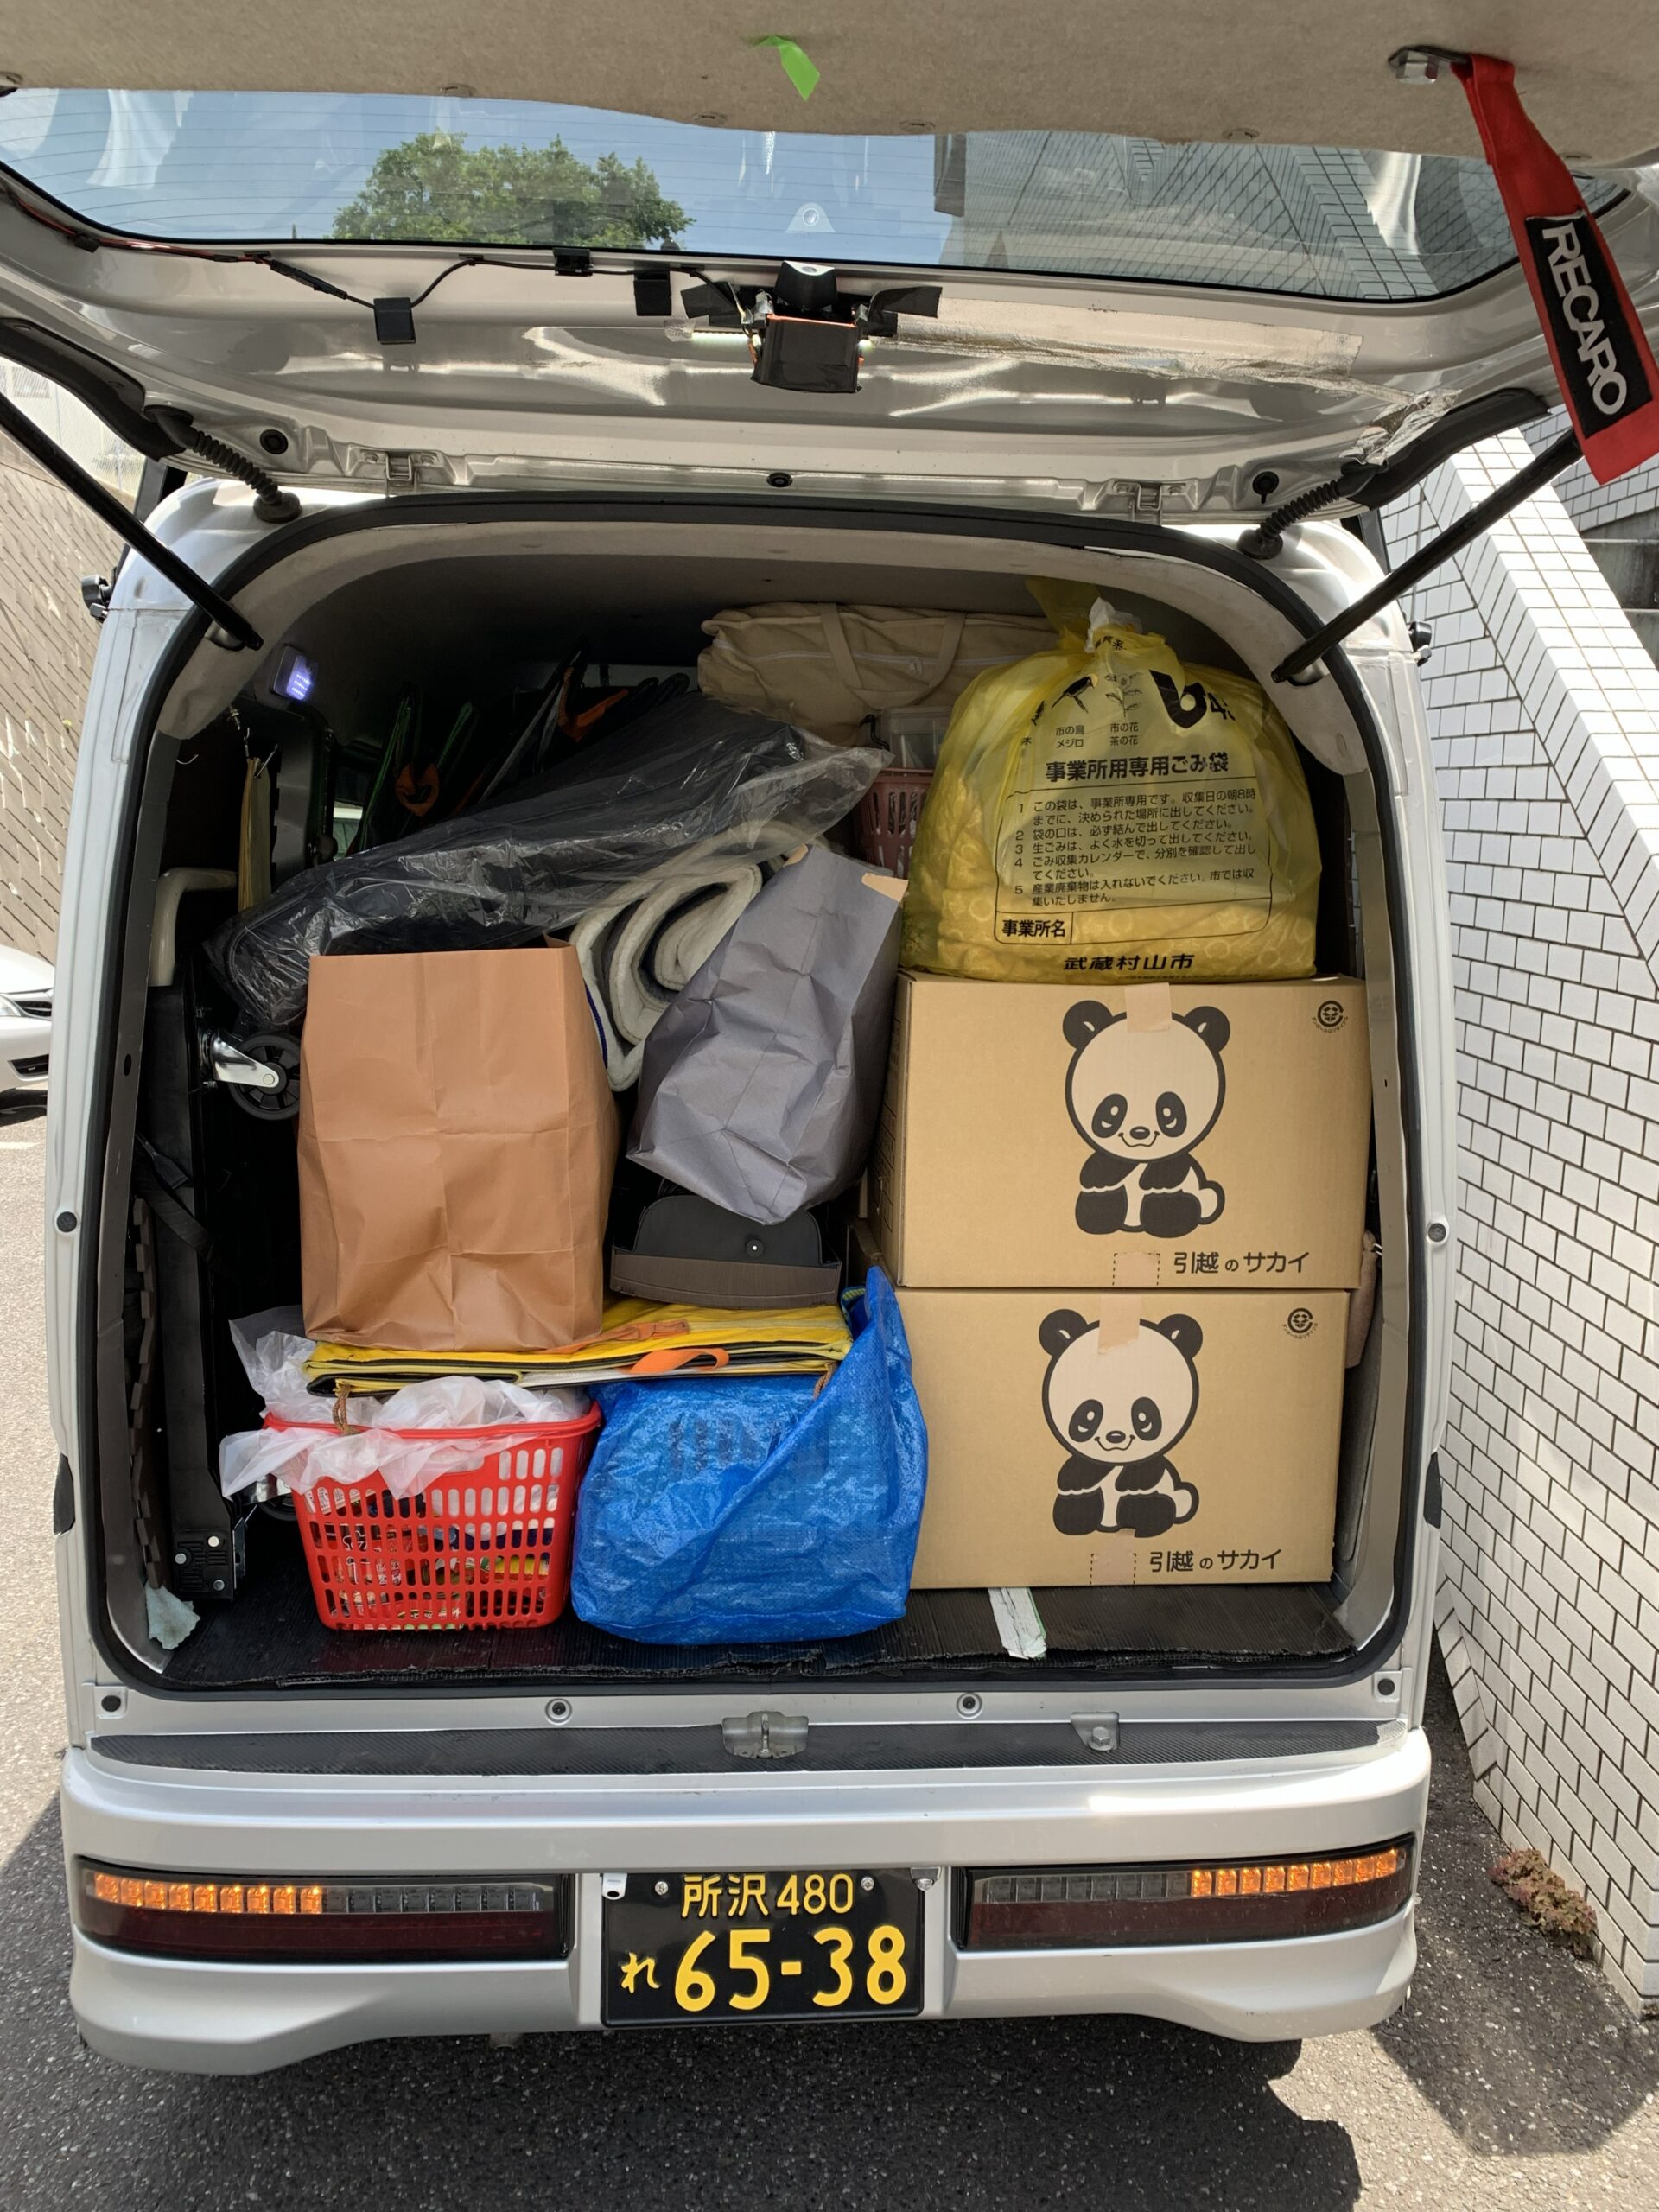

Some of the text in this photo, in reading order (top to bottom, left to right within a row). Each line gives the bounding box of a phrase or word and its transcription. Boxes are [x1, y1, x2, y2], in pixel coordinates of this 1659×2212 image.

[1542, 222, 1627, 415] RECARO
[1109, 721, 1139, 733] 市の花
[1056, 738, 1084, 749] メジロ
[1109, 734, 1139, 747] 茶の花
[1046, 751, 1230, 783] 事業所用専用ごみ袋
[1020, 804, 1024, 813] 1
[1015, 830, 1025, 841] 2
[1014, 844, 1024, 855] 3
[1014, 857, 1024, 868] 4
[1032, 868, 1095, 881] てください。
[1014, 885, 1024, 895] 5
[1032, 893, 1117, 907] 集いたしません。
[1001, 919, 1066, 938] 事業所名
[1063, 953, 1195, 970] 武蔵村山市
[1173, 1251, 1310, 1274] 引越のサカイ
[1149, 1549, 1282, 1573] 引越のサカイ
[681, 1872, 854, 1918] 所沢 480
[620, 1924, 907, 2012] れ 65-38
